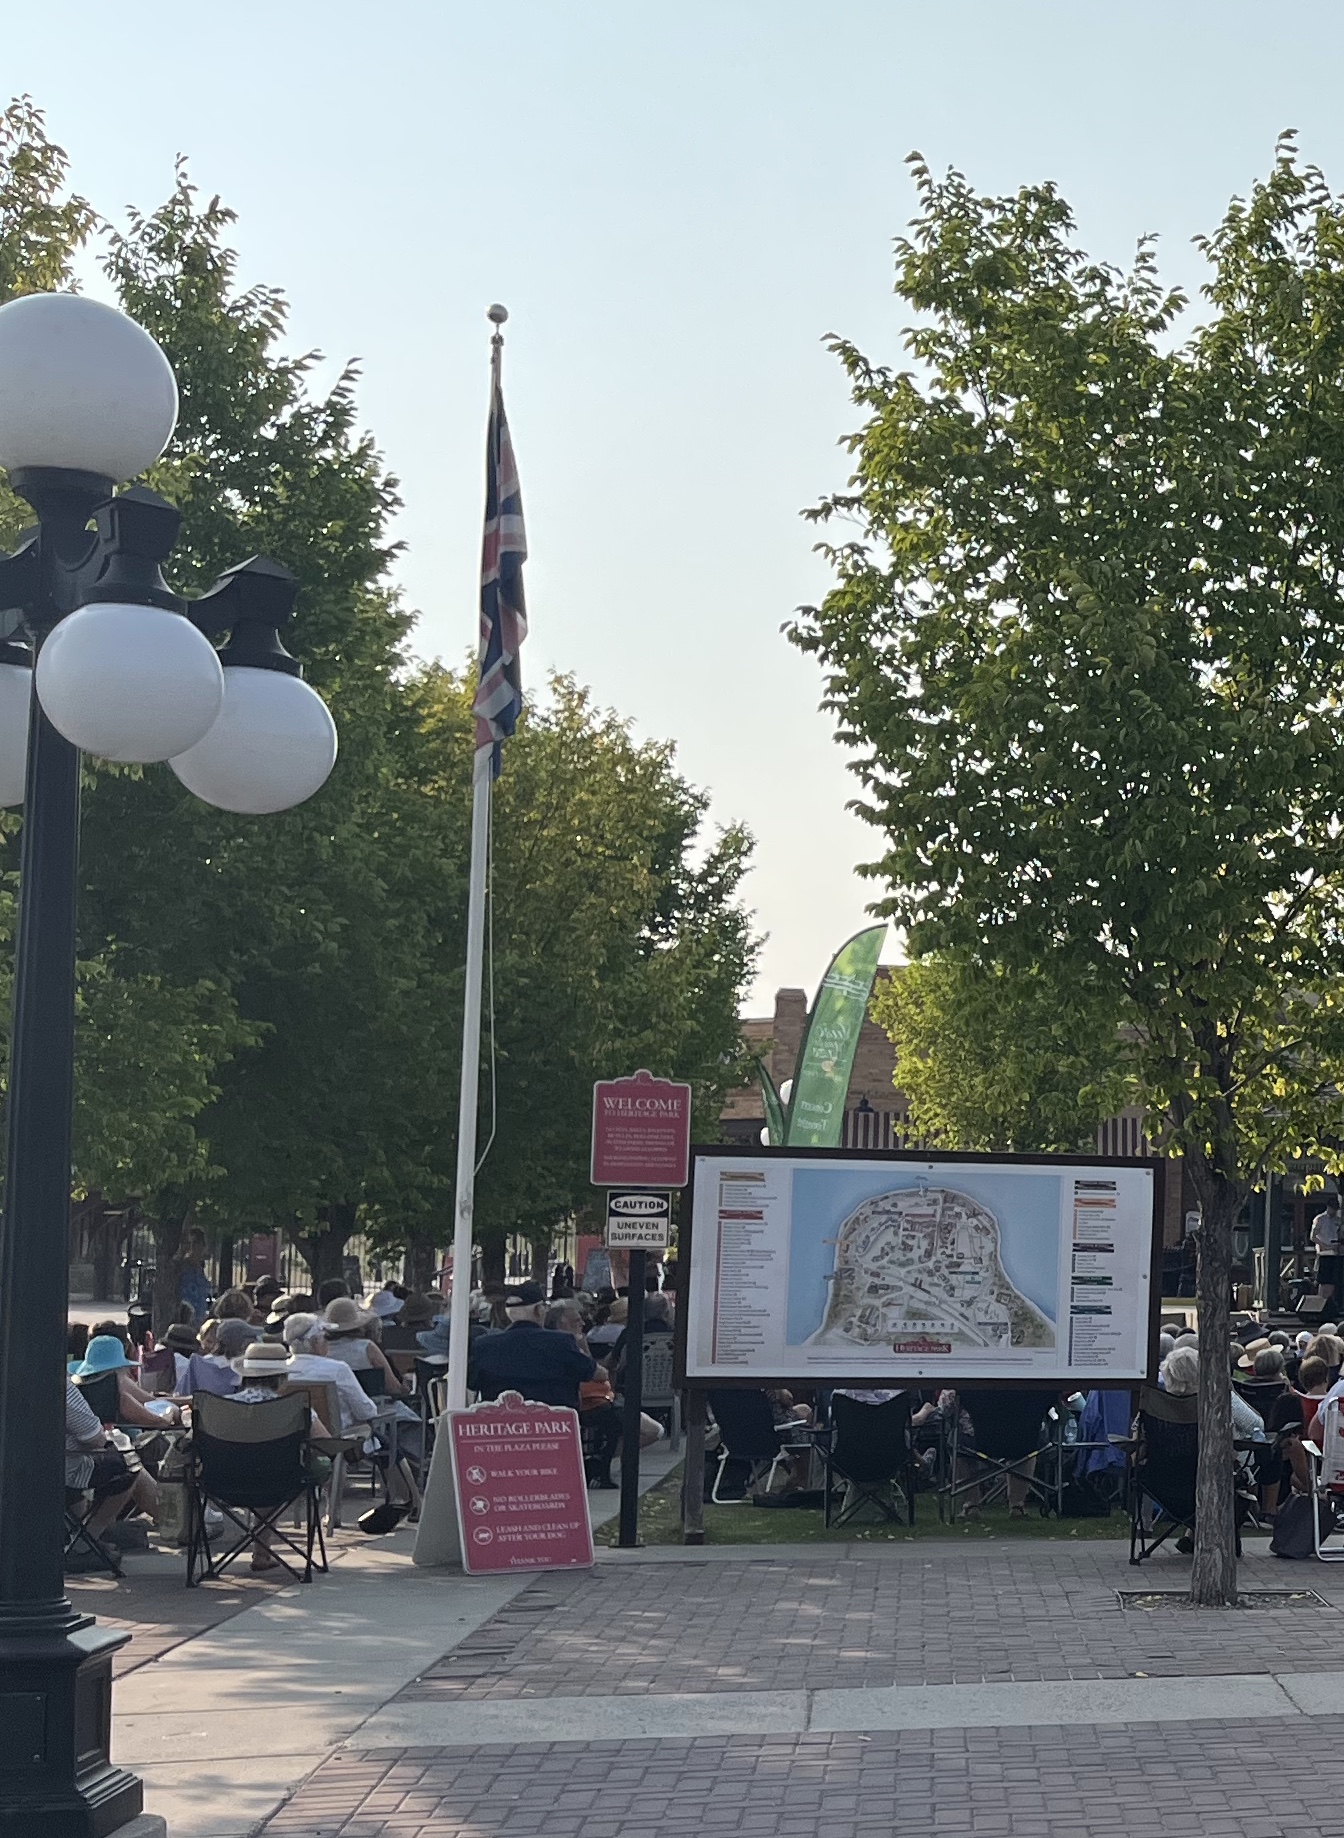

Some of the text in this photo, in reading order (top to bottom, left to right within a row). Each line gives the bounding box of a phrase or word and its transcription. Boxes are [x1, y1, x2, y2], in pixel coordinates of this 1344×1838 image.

[603, 1096, 682, 1111] WELCOME
[616, 1110, 657, 1118] HERITAGE
[659, 1110, 680, 1119] PARK
[614, 1200, 665, 1209] CAUTION
[616, 1221, 659, 1230] UNEVEN
[610, 1232, 665, 1242] SURFACES
[458, 1420, 572, 1437] HERITAGE PARK
[486, 1445, 503, 1453] THE
[504, 1444, 532, 1452] PLAZA
[532, 1443, 560, 1451] PLEASE
[490, 1468, 558, 1478] WALK YOUR BIKE
[508, 1493, 570, 1503] ROLLERBLADES
[508, 1502, 566, 1512] SKATEBOARDS
[496, 1525, 521, 1535] LEASH
[522, 1524, 541, 1533] AND
[542, 1523, 569, 1532] CLEAN
[497, 1533, 523, 1543] AFTER
[524, 1532, 546, 1541] YOUR
